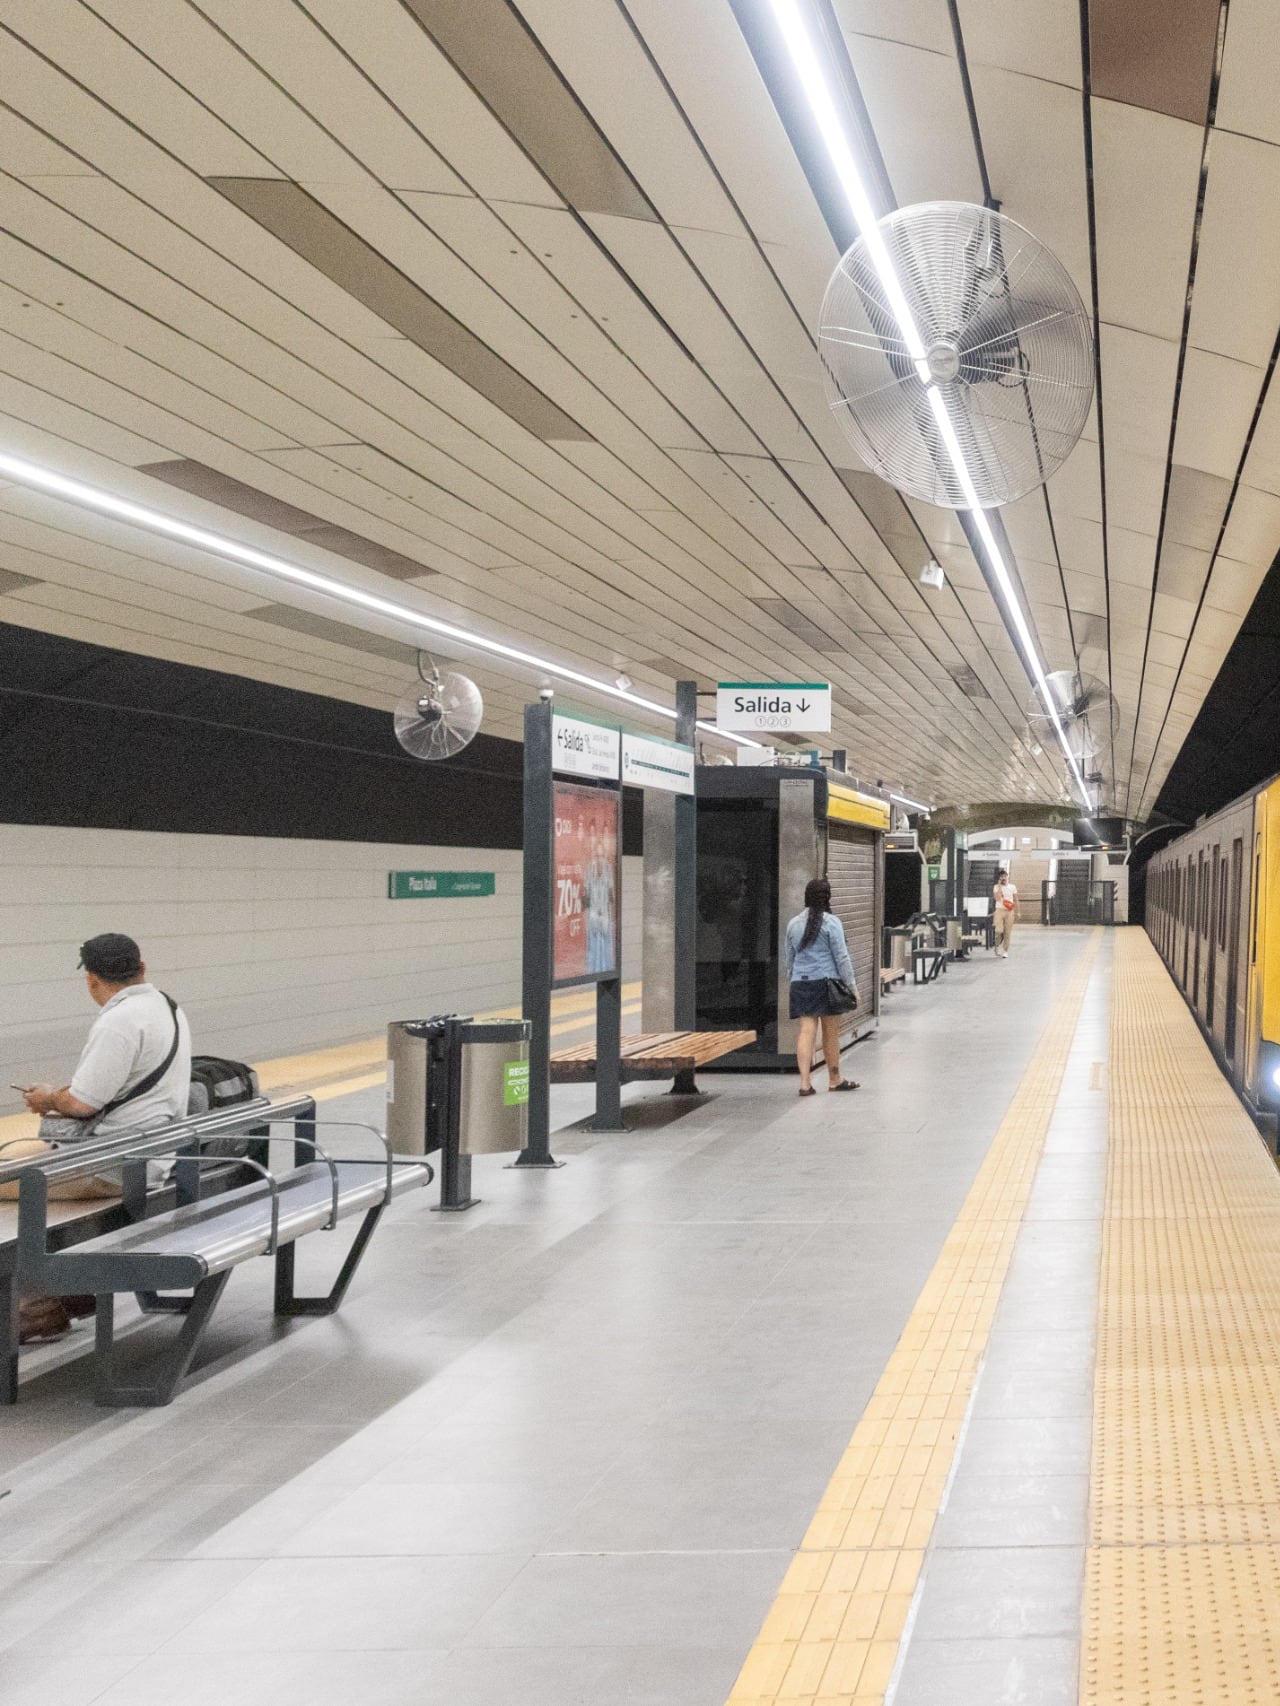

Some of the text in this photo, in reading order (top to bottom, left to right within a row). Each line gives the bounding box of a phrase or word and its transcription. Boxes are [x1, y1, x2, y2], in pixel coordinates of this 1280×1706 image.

[734, 696, 791, 713] Salida
[564, 729, 583, 752] Salida
[557, 879, 582, 917] 70%
